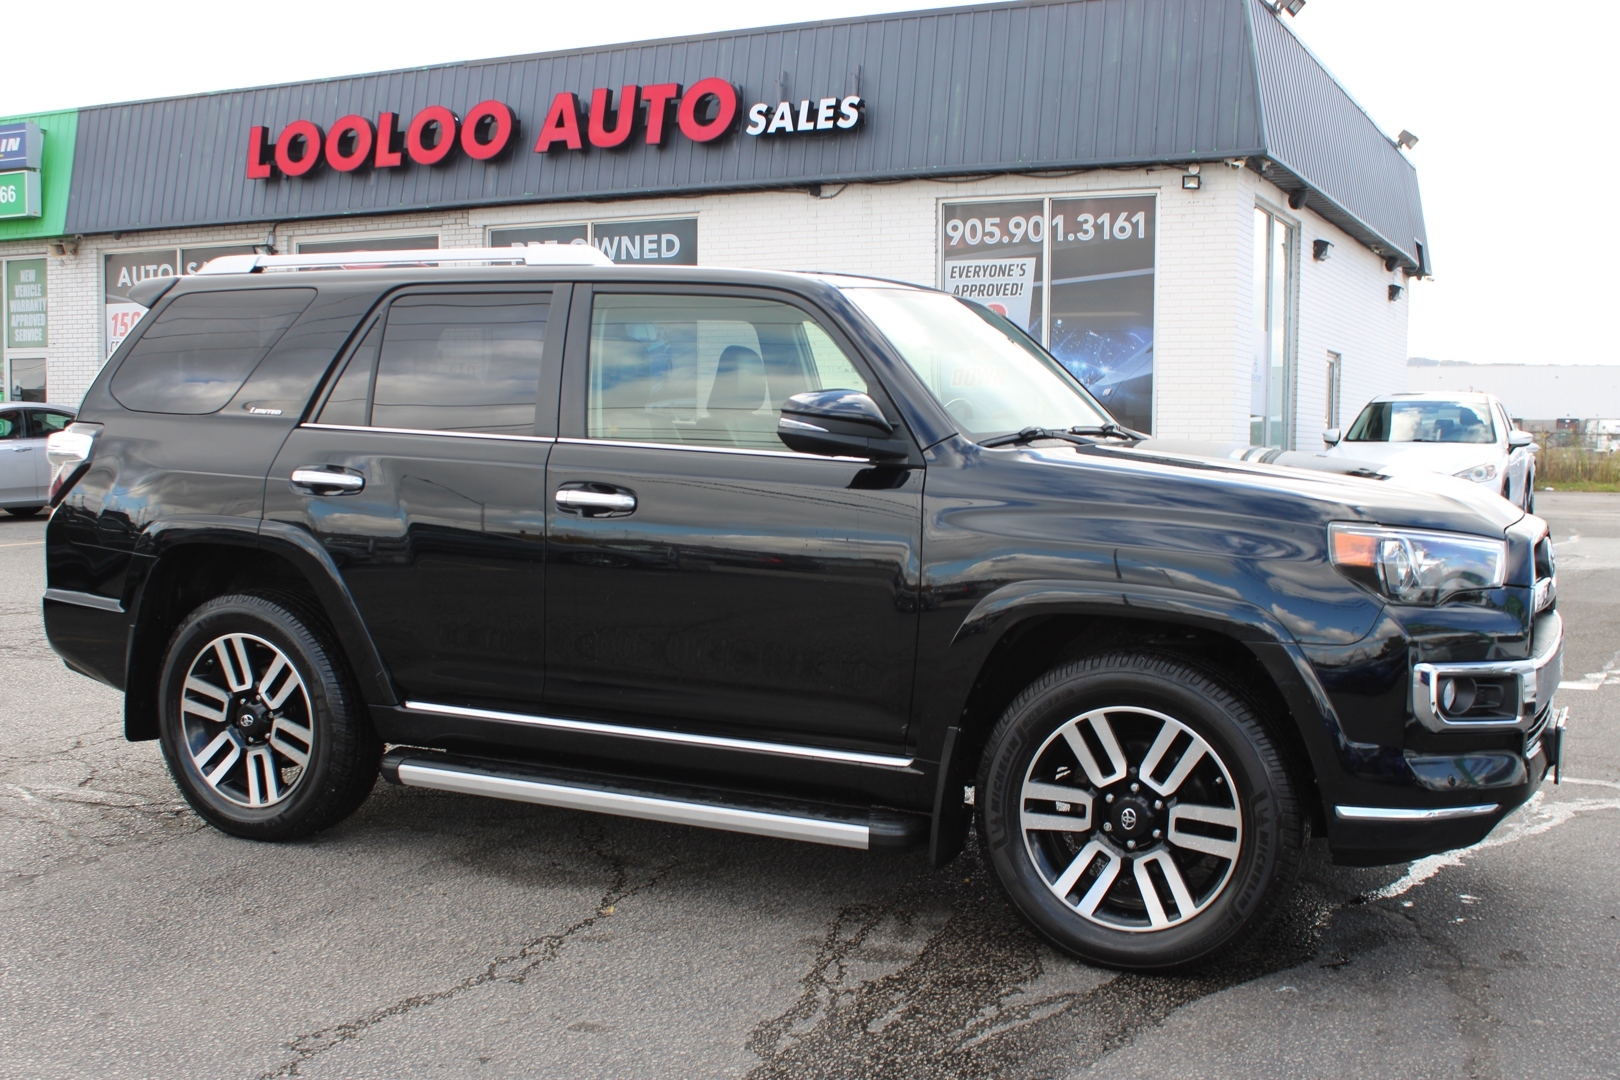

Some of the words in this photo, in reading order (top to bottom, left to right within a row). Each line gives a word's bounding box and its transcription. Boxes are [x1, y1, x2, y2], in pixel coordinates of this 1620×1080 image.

[247, 99, 514, 180] LOOLOO
[533, 77, 739, 153] AUTO
[745, 95, 861, 136] SALES
[946, 211, 1145, 246] 905.901.3161
[20, 269, 36, 283] NEW
[117, 263, 174, 287] AUTO
[949, 263, 1027, 279] EVERYONE'S
[14, 284, 42, 298] VEHICLE
[953, 282, 1024, 298] APPROVED!
[9, 299, 47, 312] WARRANTY
[11, 313, 46, 327] APPROVED
[15, 328, 43, 342] SERVICE
[990, 736, 1020, 814] MICHELIN
[1237, 829, 1270, 911] MICHELIN
